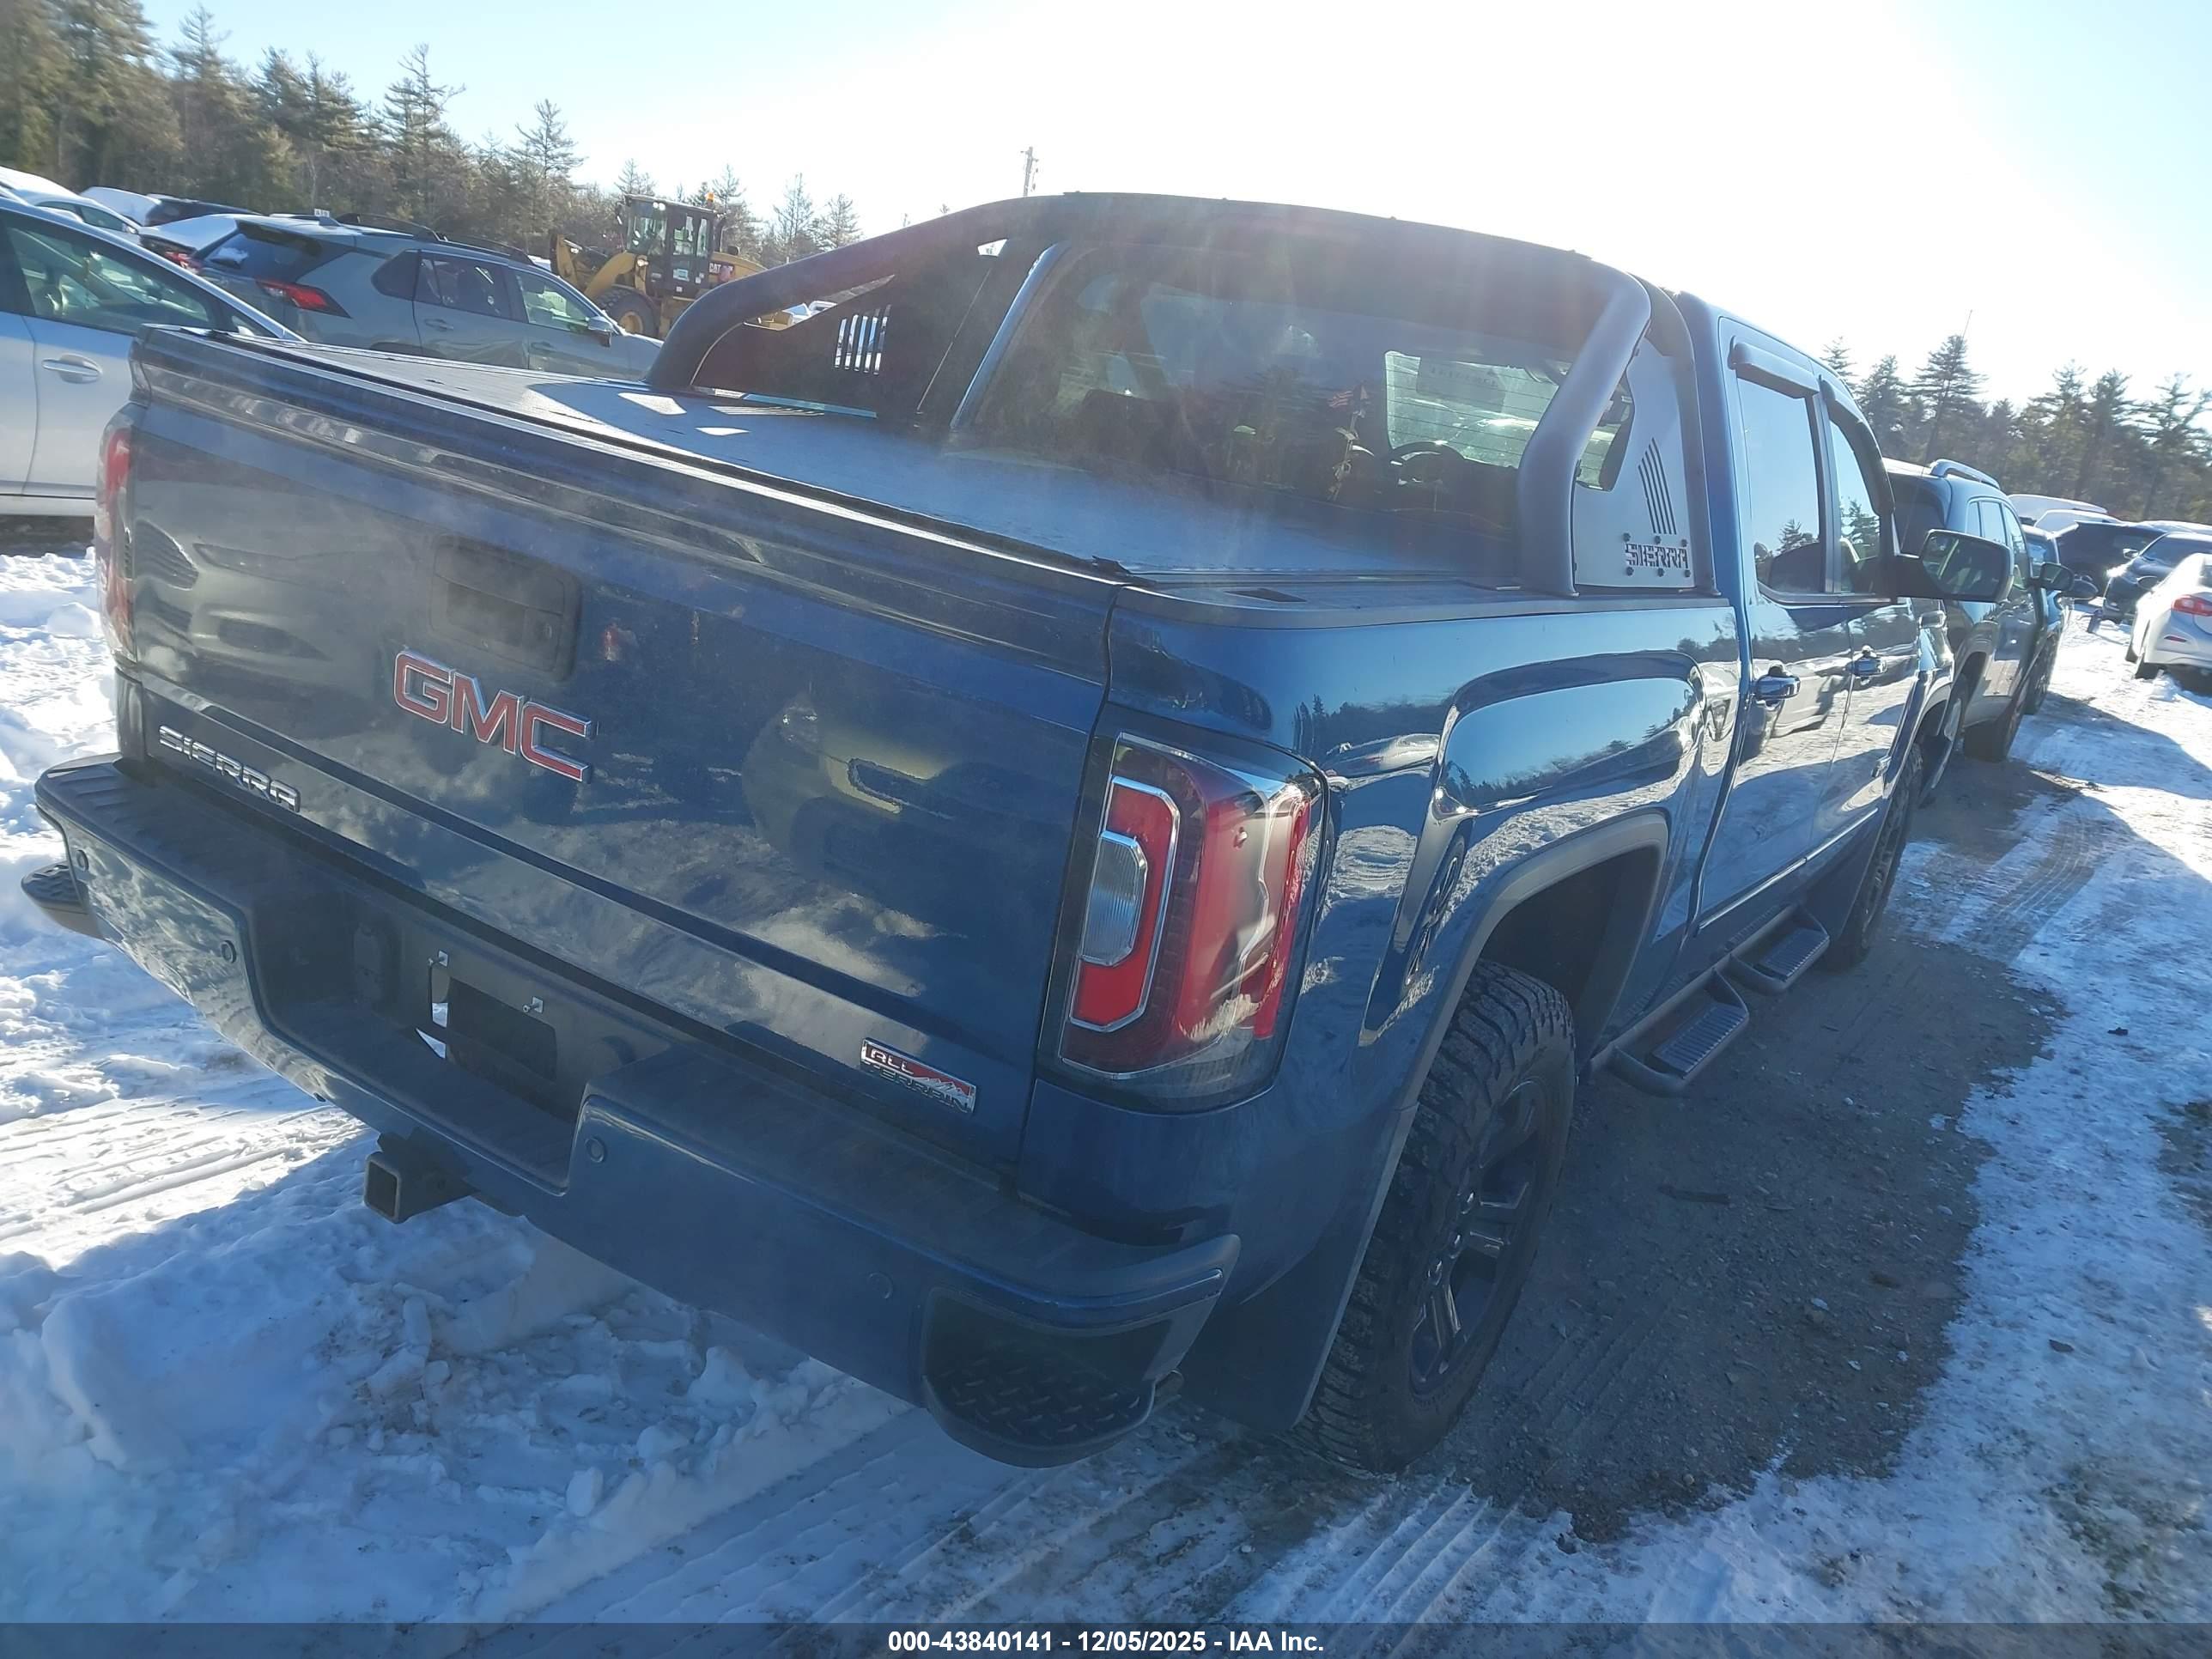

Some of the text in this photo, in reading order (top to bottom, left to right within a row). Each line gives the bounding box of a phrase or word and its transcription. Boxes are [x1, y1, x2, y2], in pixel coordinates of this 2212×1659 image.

[709, 263, 721, 274] CAT
[1625, 543, 1689, 569] SIERRA
[393, 648, 592, 781] GMC
[158, 725, 301, 812] SIERRA
[871, 1050, 914, 1074] ALL
